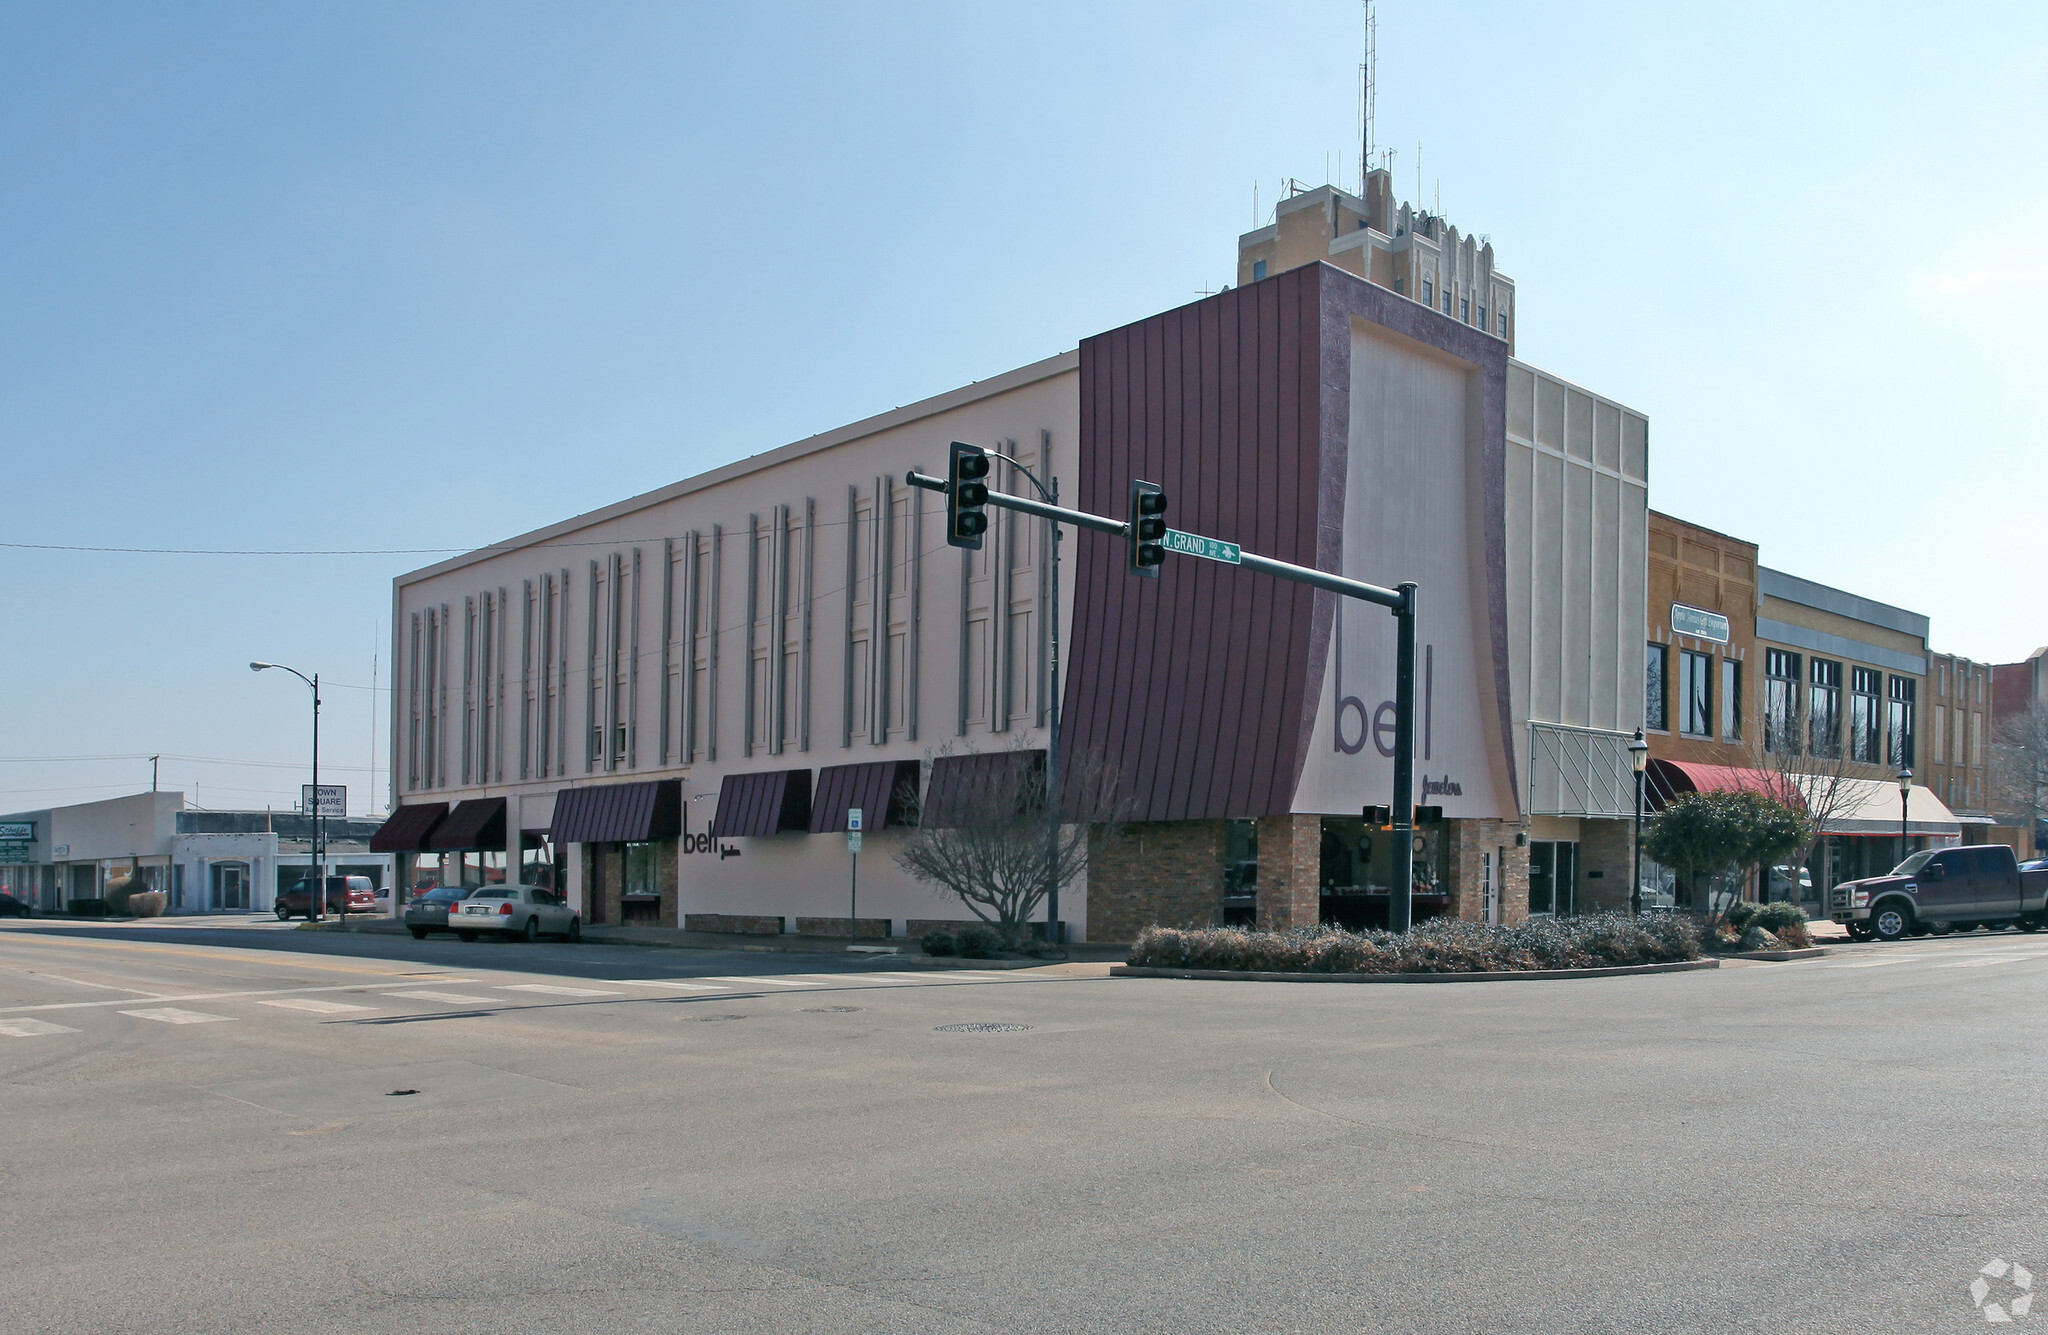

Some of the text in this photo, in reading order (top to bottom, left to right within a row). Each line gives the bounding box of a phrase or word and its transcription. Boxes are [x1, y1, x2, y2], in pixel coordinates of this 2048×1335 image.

[1163, 532, 1205, 554] N. GRAND
[1335, 593, 1433, 761] bel
[317, 788, 337, 796] OWN
